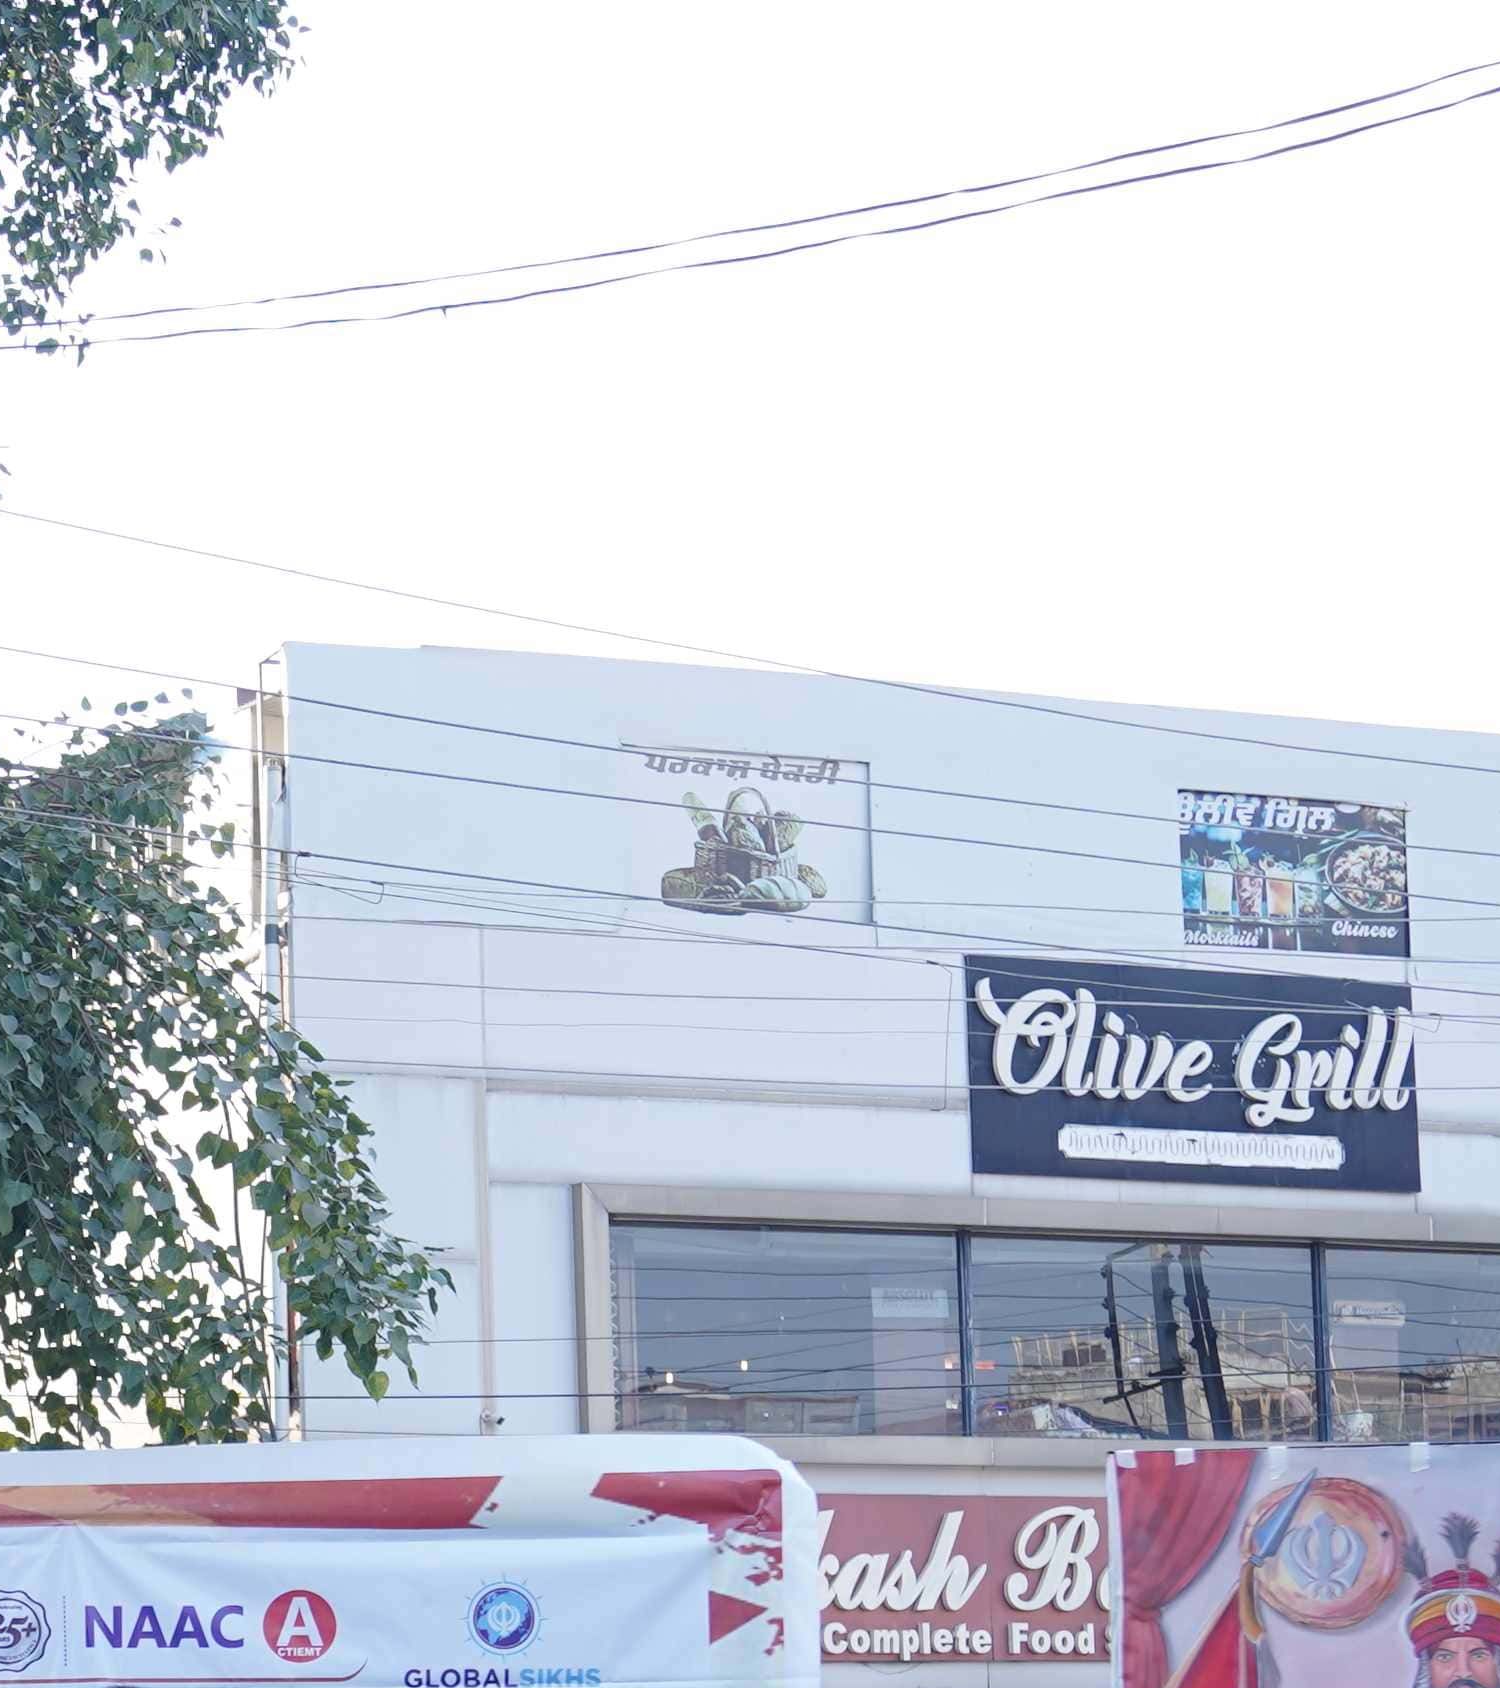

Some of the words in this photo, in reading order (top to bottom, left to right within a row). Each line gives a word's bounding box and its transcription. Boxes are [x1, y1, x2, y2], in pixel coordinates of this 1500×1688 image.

[1332, 918, 1399, 939] Chinese
[975, 977, 1214, 1103] Olive
[1235, 1006, 1414, 1128] Grill
[84, 1604, 245, 1649] NAAC
[275, 1596, 325, 1647] A
[823, 1621, 993, 1661] Complete
[1009, 1622, 1096, 1655] Food
[276, 1647, 323, 1657] CTIEMT
[404, 1667, 601, 1688] GLOBALSIKHS
